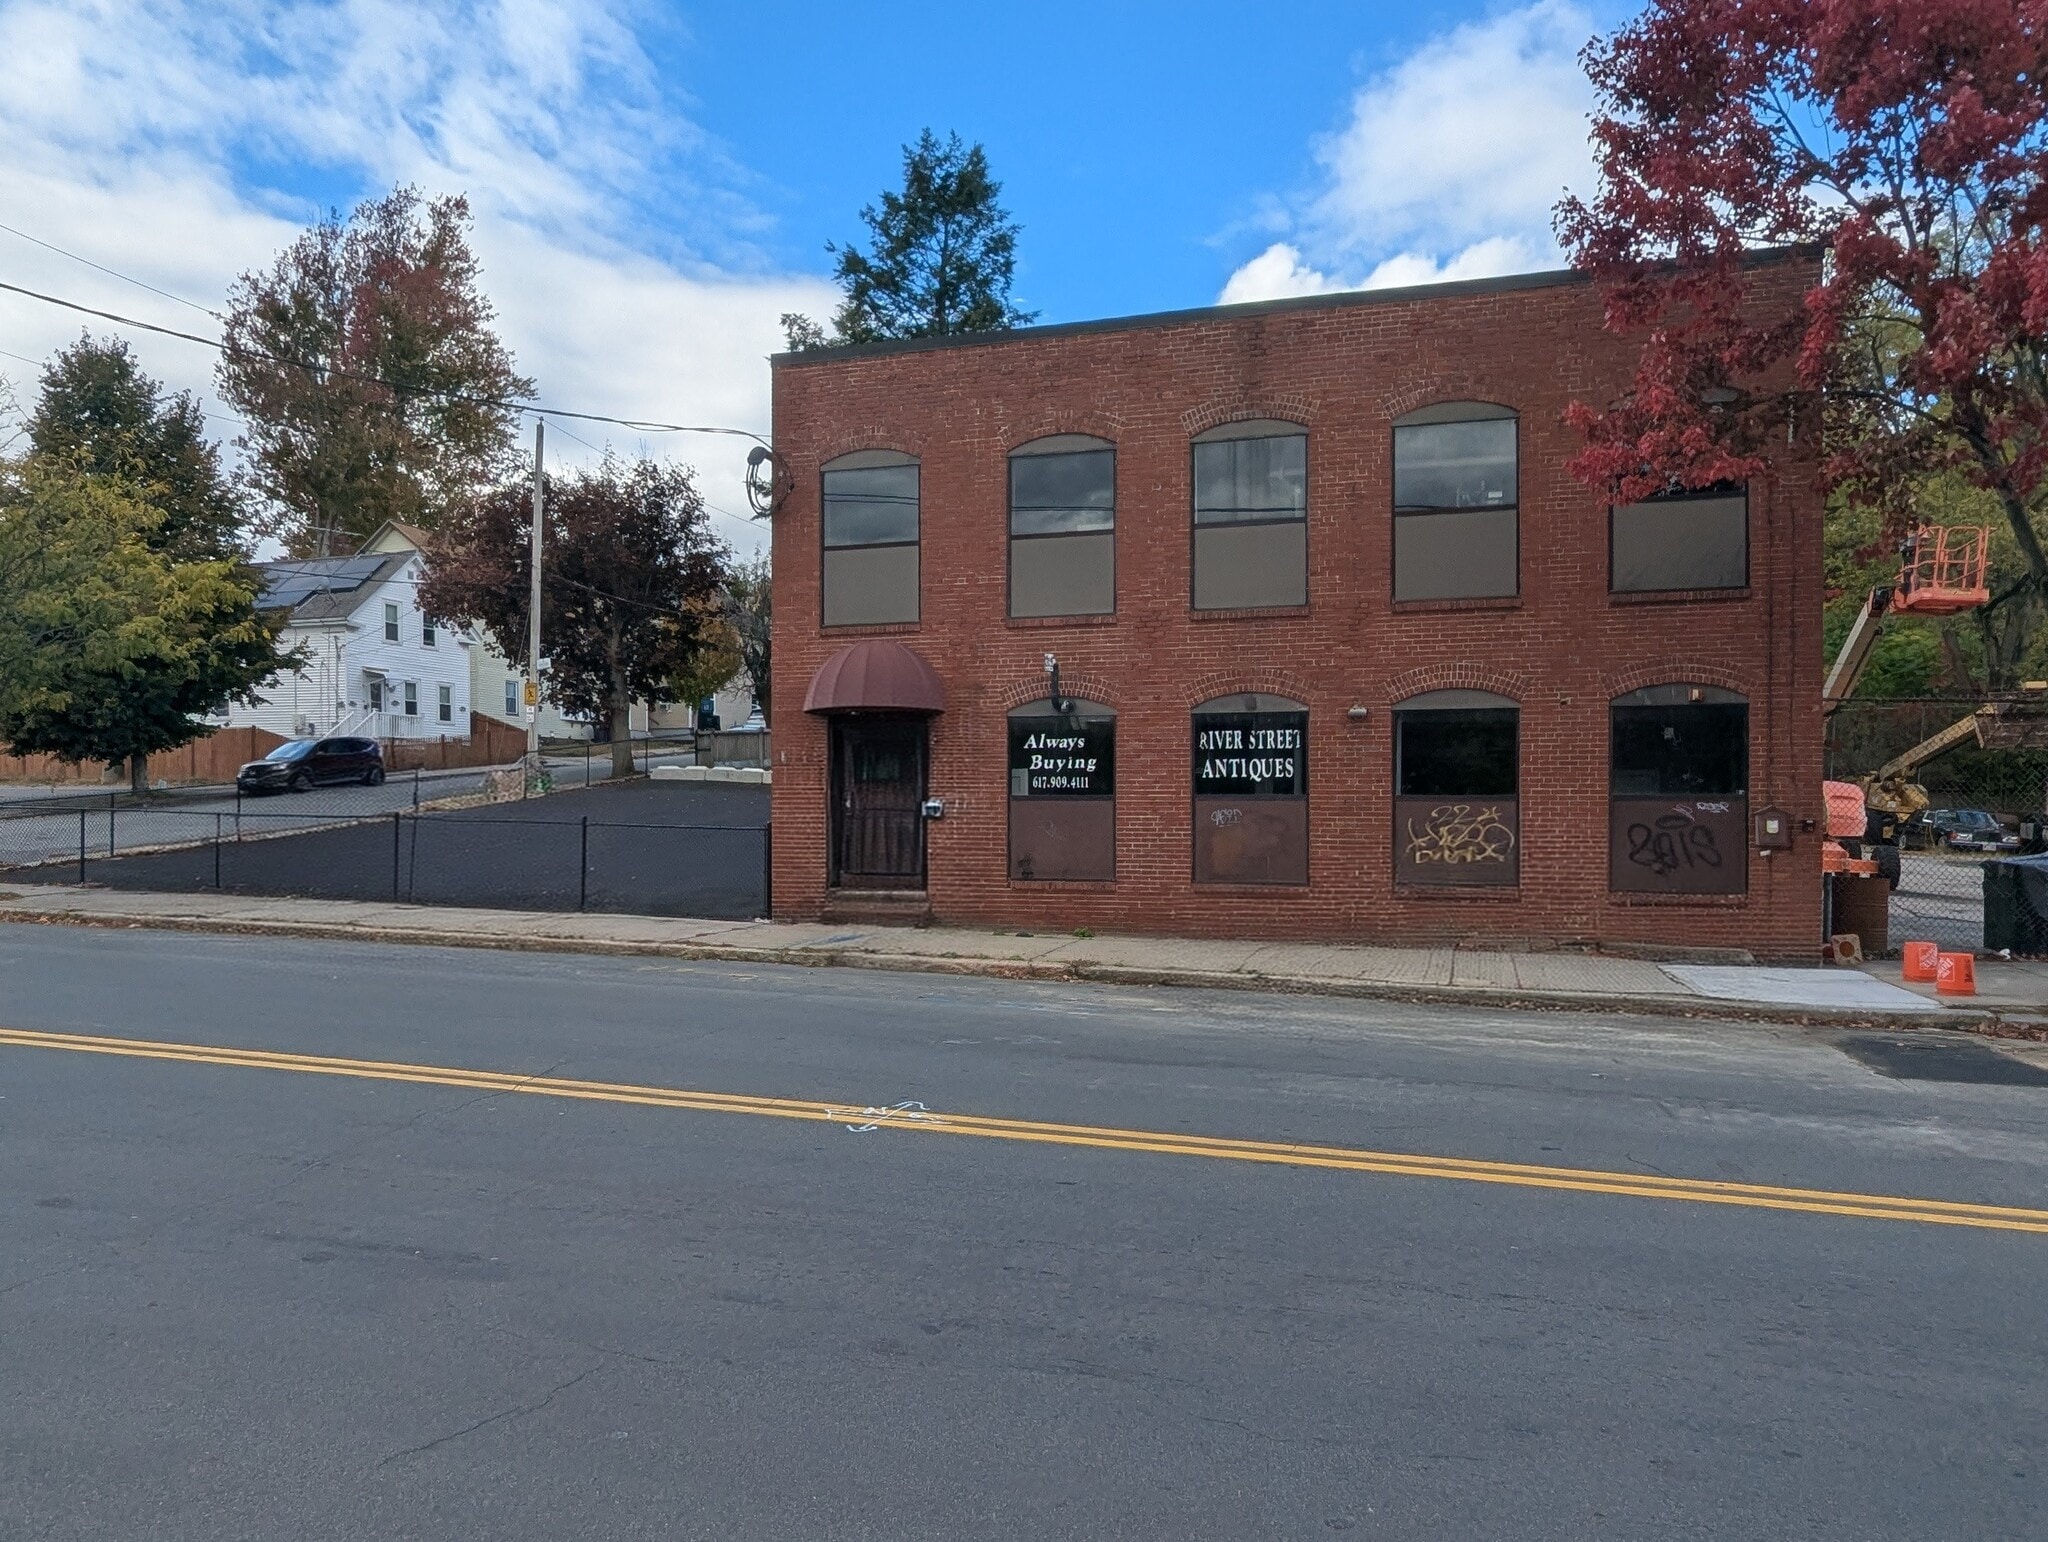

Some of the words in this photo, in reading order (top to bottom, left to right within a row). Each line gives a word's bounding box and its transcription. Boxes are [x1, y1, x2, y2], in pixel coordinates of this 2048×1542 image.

[1023, 733, 1085, 751] Always
[1199, 729, 1243, 750] RIVER
[1248, 729, 1301, 750] STREET
[1029, 754, 1097, 772] Buying
[1202, 758, 1294, 782] ANTIQUES
[1032, 776, 1089, 789] 617.909.4111
